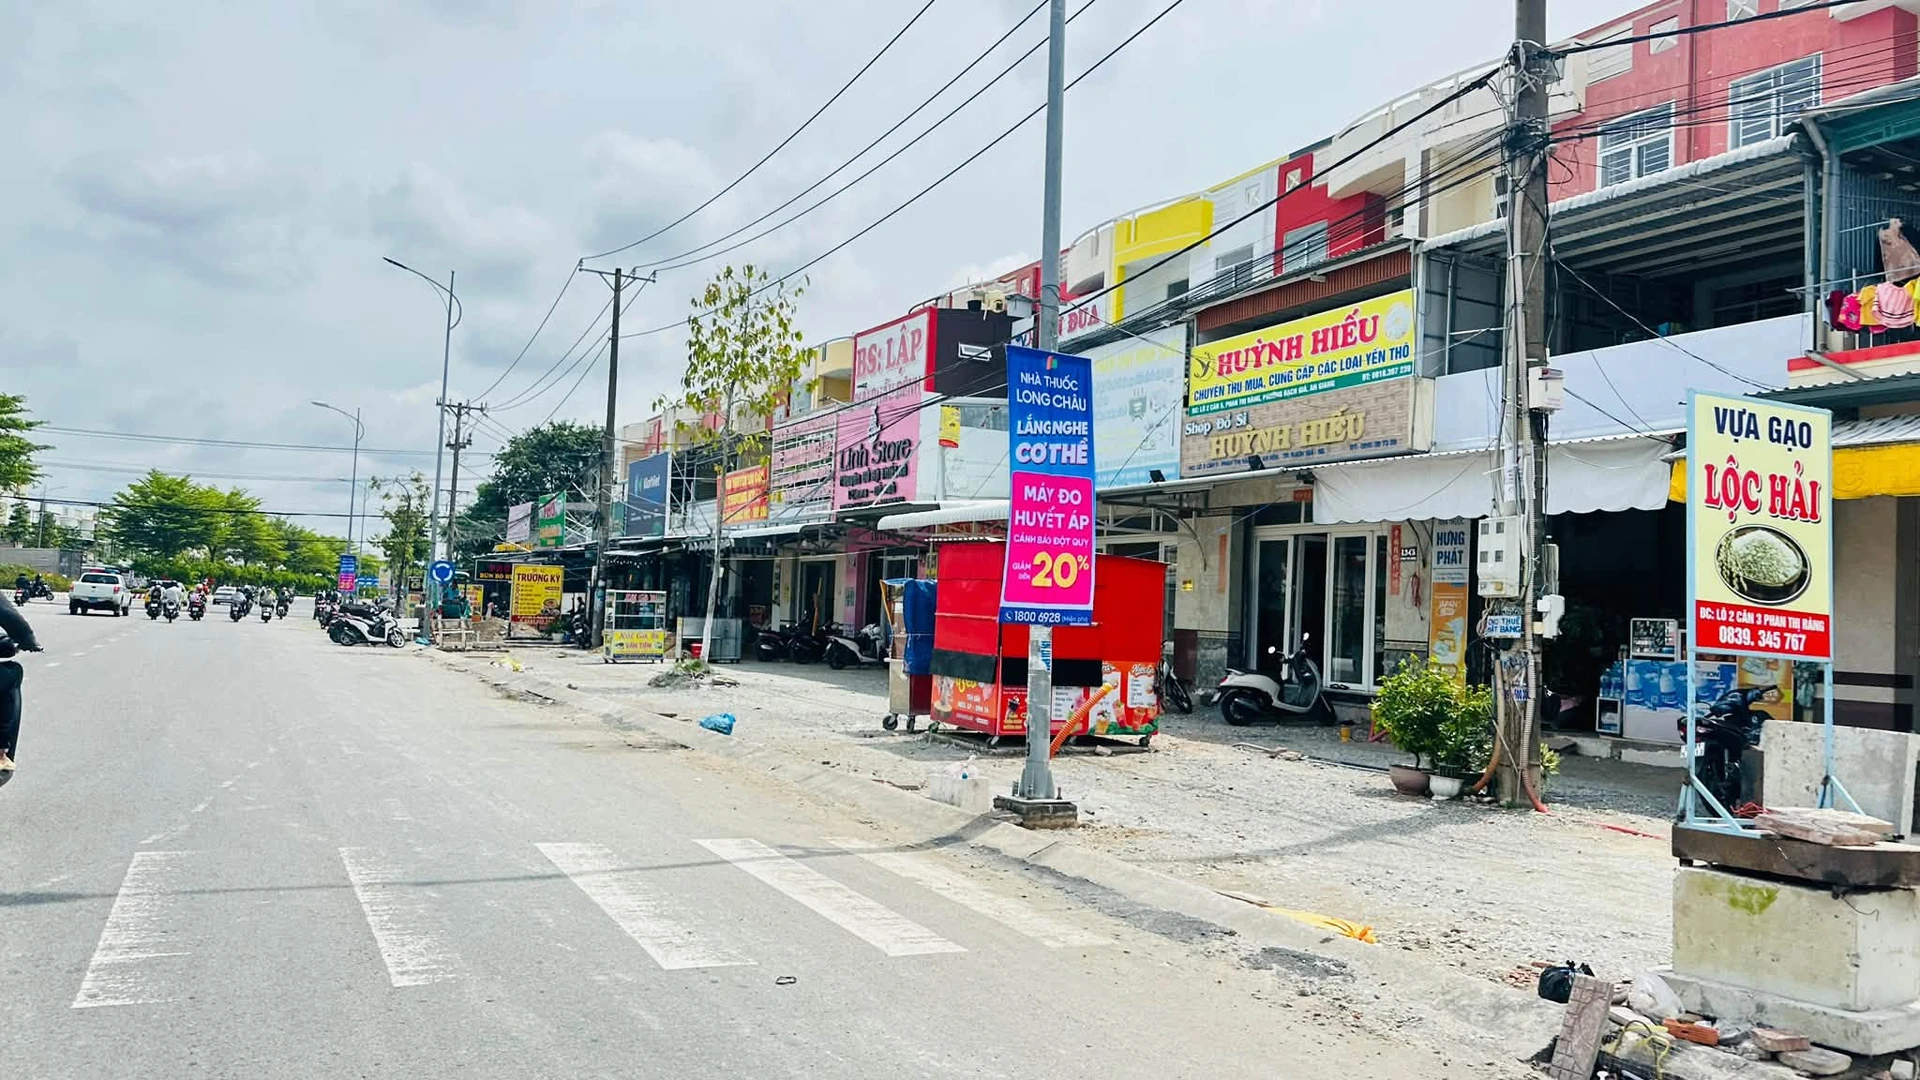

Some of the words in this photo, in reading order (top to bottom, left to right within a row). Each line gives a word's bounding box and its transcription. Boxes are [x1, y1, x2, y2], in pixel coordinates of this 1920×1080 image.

[1310, 309, 1380, 356] HIẾU
[857, 345, 883, 378] BS:
[886, 323, 923, 374] LẬP
[1020, 371, 1042, 386] NHÀ
[1044, 373, 1079, 391] THUỐC
[1193, 386, 1225, 402] CHUYÊN
[1226, 380, 1243, 394] THU
[1268, 372, 1294, 388] CUNG
[1316, 360, 1338, 377] CÁC
[1338, 355, 1363, 372] LOẠI
[1364, 345, 1387, 365] YẾN
[1016, 389, 1051, 407] LONG
[1052, 392, 1087, 411] CHÂU
[1016, 413, 1050, 436] LẮNG
[1050, 420, 1089, 437] NGHE
[1184, 421, 1213, 437] Shop
[1300, 404, 1367, 450] HIẾU
[1714, 406, 1760, 444] VỰA
[1767, 415, 1812, 452] GẠO
[839, 446, 869, 472] Linh
[870, 438, 912, 464] Store
[1015, 442, 1049, 465] CƠ
[1048, 437, 1089, 466] THỂ
[1024, 484, 1055, 505] MÁY
[1057, 488, 1083, 505] ĐO
[1704, 454, 1762, 523] LỘC
[1767, 460, 1820, 523] HẢI
[1014, 507, 1067, 530] HUYẾT
[1068, 509, 1090, 530] ÁP
[1013, 532, 1037, 544] CẢNH
[1036, 533, 1052, 545] BÁO
[1053, 534, 1071, 547] ĐỘT
[1436, 530, 1466, 547] HƯNG
[1012, 560, 1032, 571] GIẢM
[1436, 546, 1464, 565] PHÁT
[1031, 550, 1090, 589] 20%
[1014, 610, 1037, 622] 1800
[1037, 611, 1061, 623] 6928
[1501, 615, 1520, 624] THUÊ
[1715, 609, 1727, 622] LÔ
[1728, 611, 1736, 623] 2
[1736, 610, 1755, 625] CĂN
[1756, 613, 1763, 625] 3
[1763, 614, 1787, 628] PHAN
[1788, 617, 1801, 632] THỊ
[1718, 625, 1755, 647] 0839.
[1757, 629, 1782, 650] 345
[1783, 632, 1807, 652] 767
